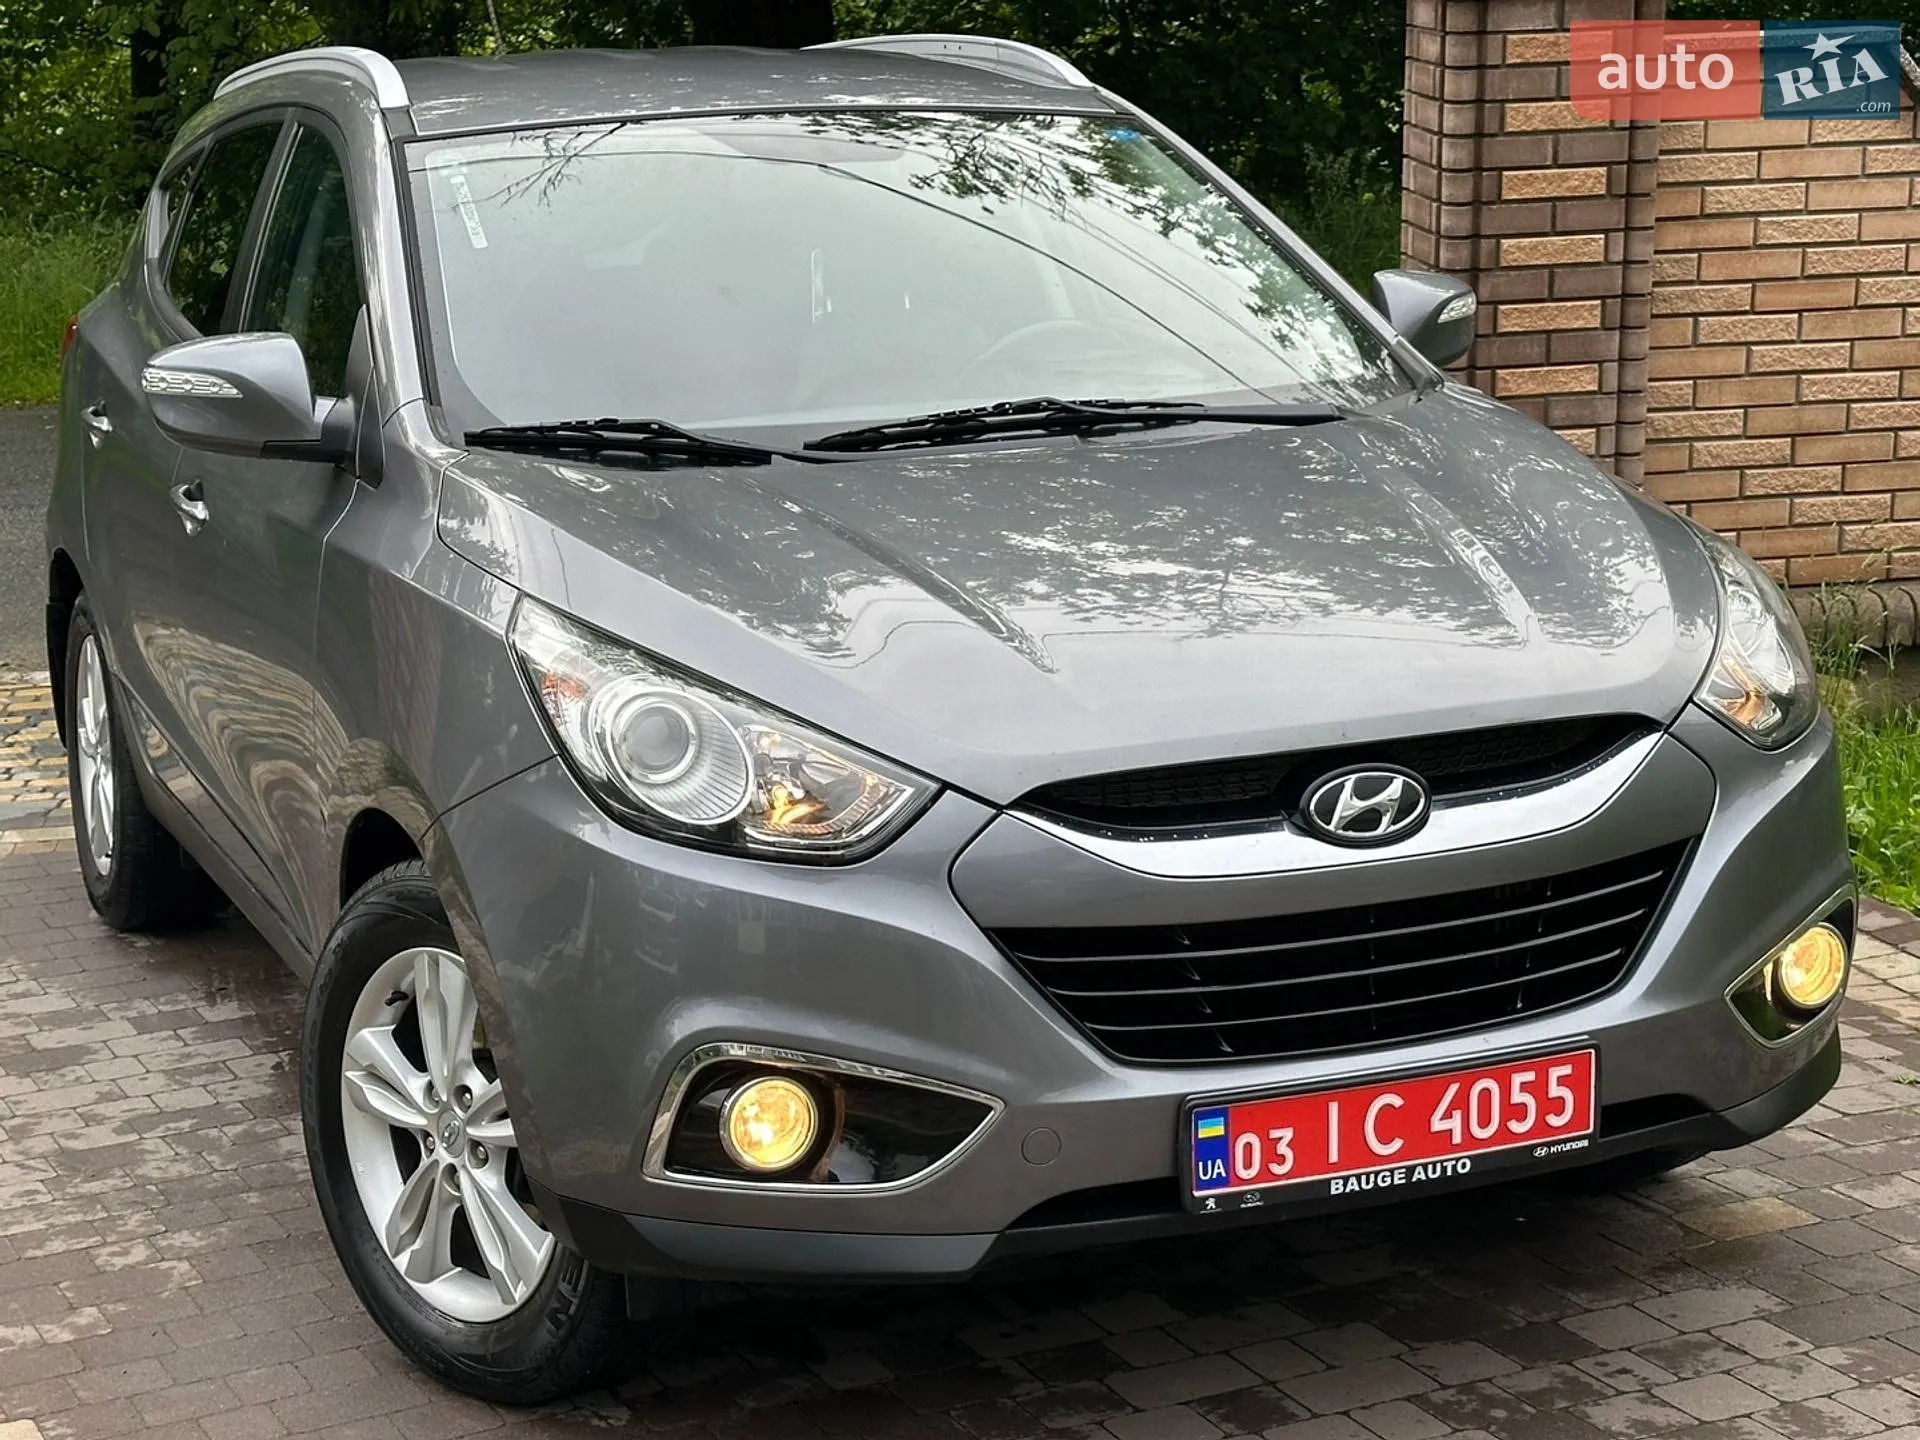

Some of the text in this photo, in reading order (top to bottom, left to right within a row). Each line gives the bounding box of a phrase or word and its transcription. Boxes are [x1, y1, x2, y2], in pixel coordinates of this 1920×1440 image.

[1234, 1126, 1295, 1181] 03
[1430, 1064, 1574, 1145] 4055
[1199, 1158, 1226, 1180] UA
[1330, 1157, 1472, 1195] BAUGE AUTO
